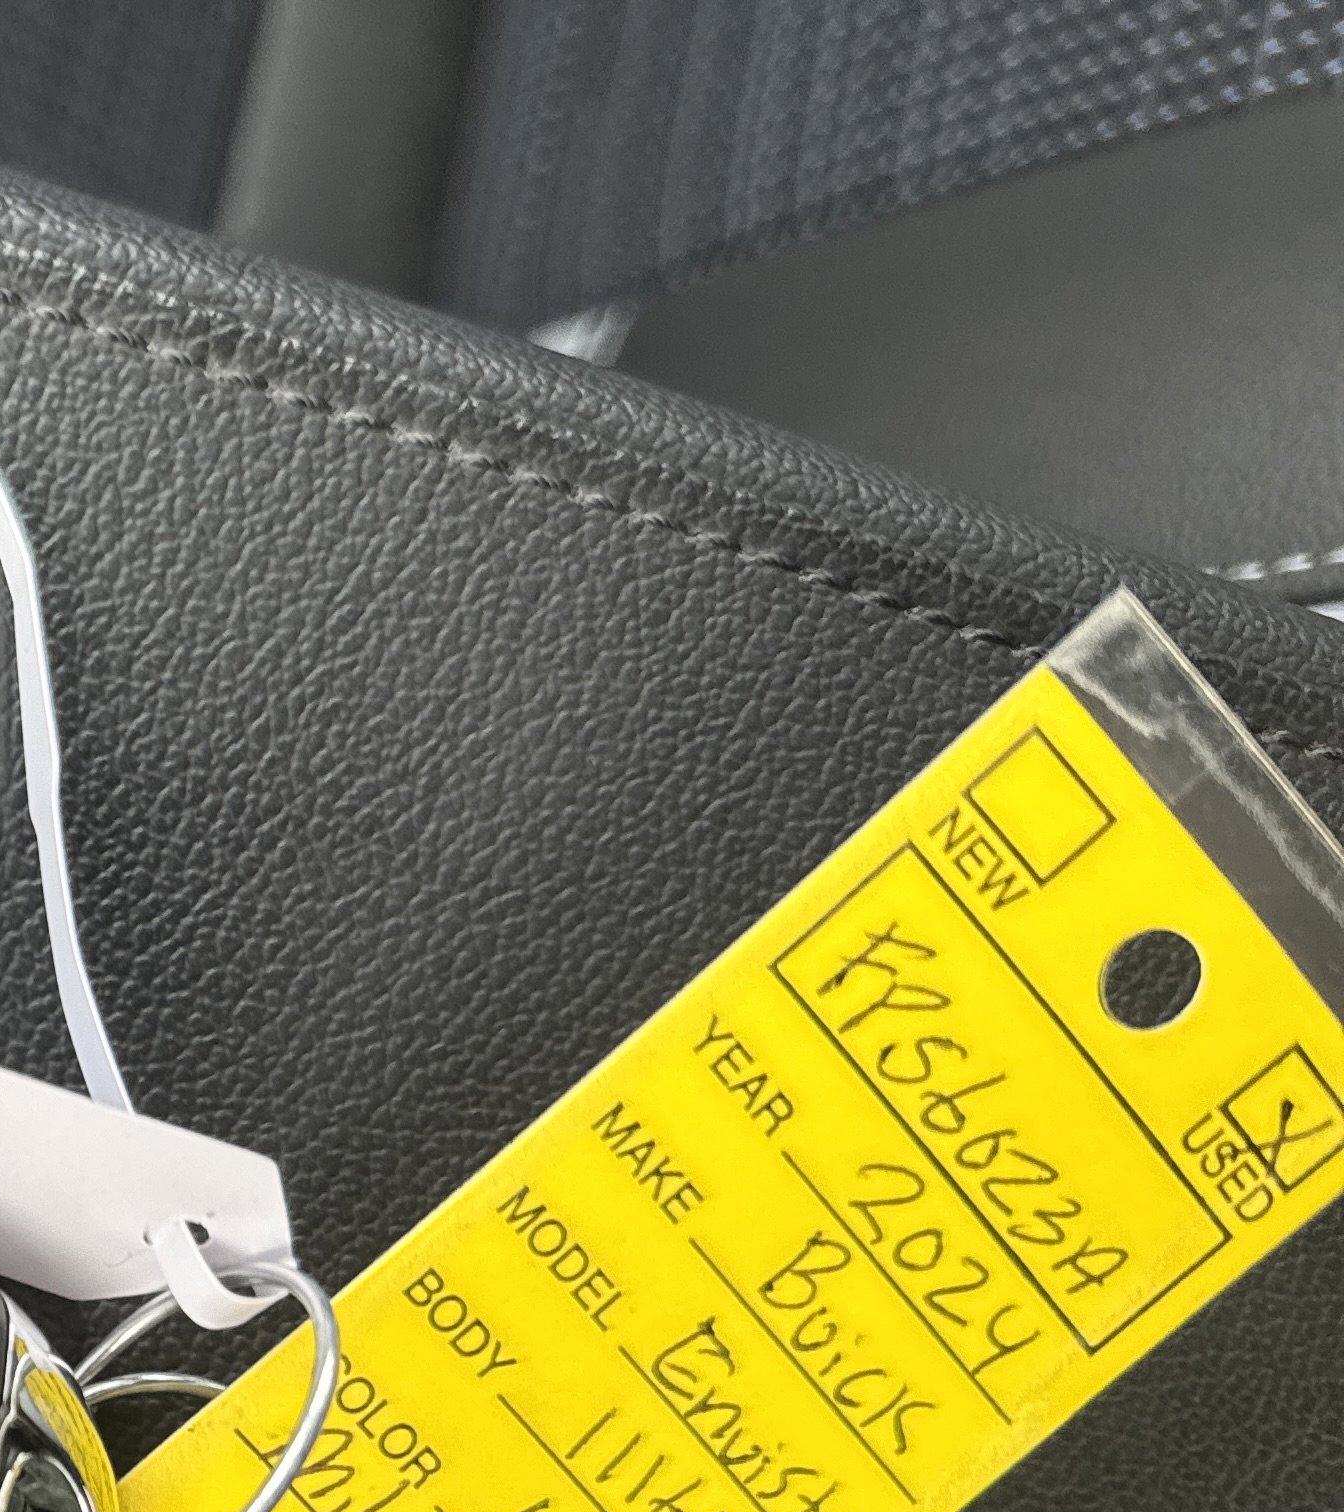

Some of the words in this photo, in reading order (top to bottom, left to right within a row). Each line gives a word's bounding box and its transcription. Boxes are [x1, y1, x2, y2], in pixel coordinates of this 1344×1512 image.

[927, 806, 1030, 912] NEW
[692, 1013, 795, 1138] YEAR
[591, 1101, 705, 1225] MAKE
[1181, 1111, 1274, 1223] USED
[496, 1184, 623, 1333] MODEL
[848, 1162, 1041, 1377] 2024
[401, 1267, 518, 1379] BODY
[757, 1229, 937, 1456] Buick
